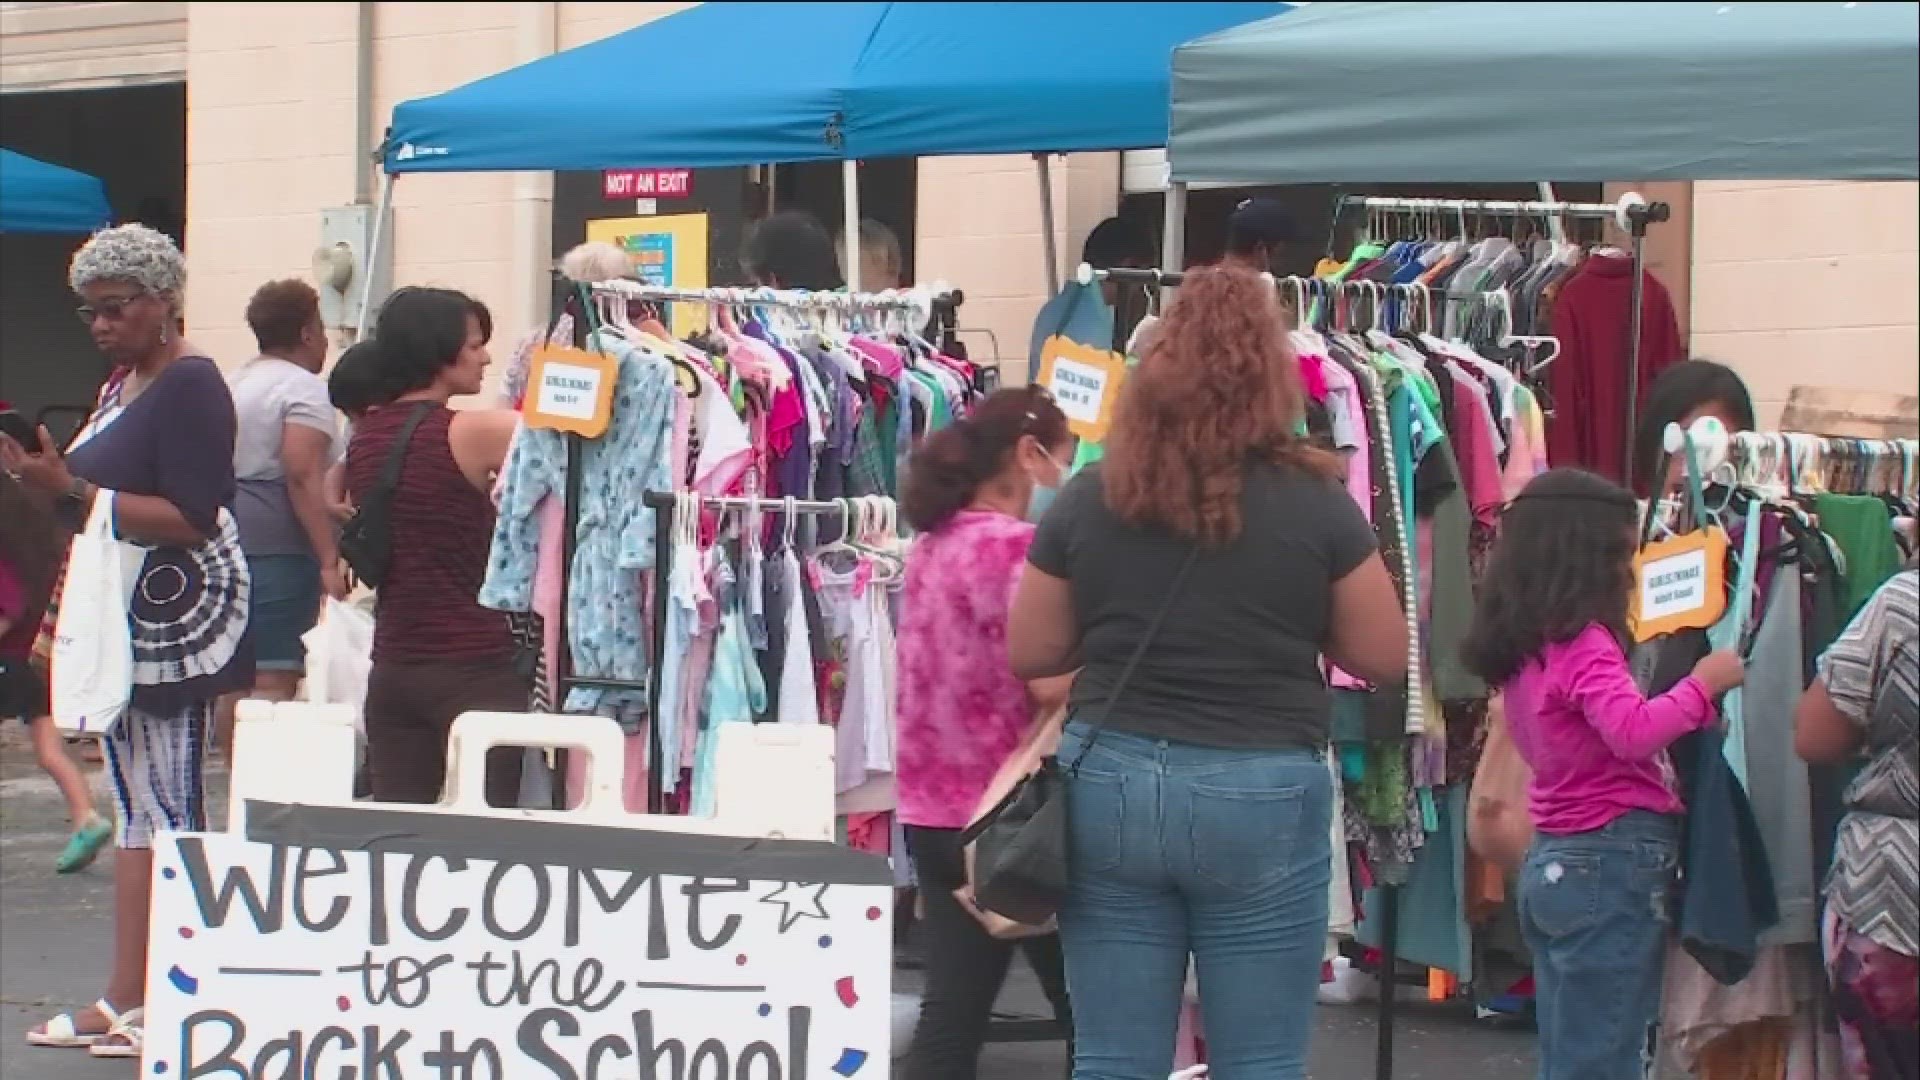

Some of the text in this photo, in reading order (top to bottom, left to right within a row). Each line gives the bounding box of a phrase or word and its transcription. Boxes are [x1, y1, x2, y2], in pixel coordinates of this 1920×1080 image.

[607, 171, 689, 194] NOT AN EXIT
[337, 950, 626, 1013] to the
[180, 1009, 412, 1080] Back
[516, 1006, 812, 1080] School
